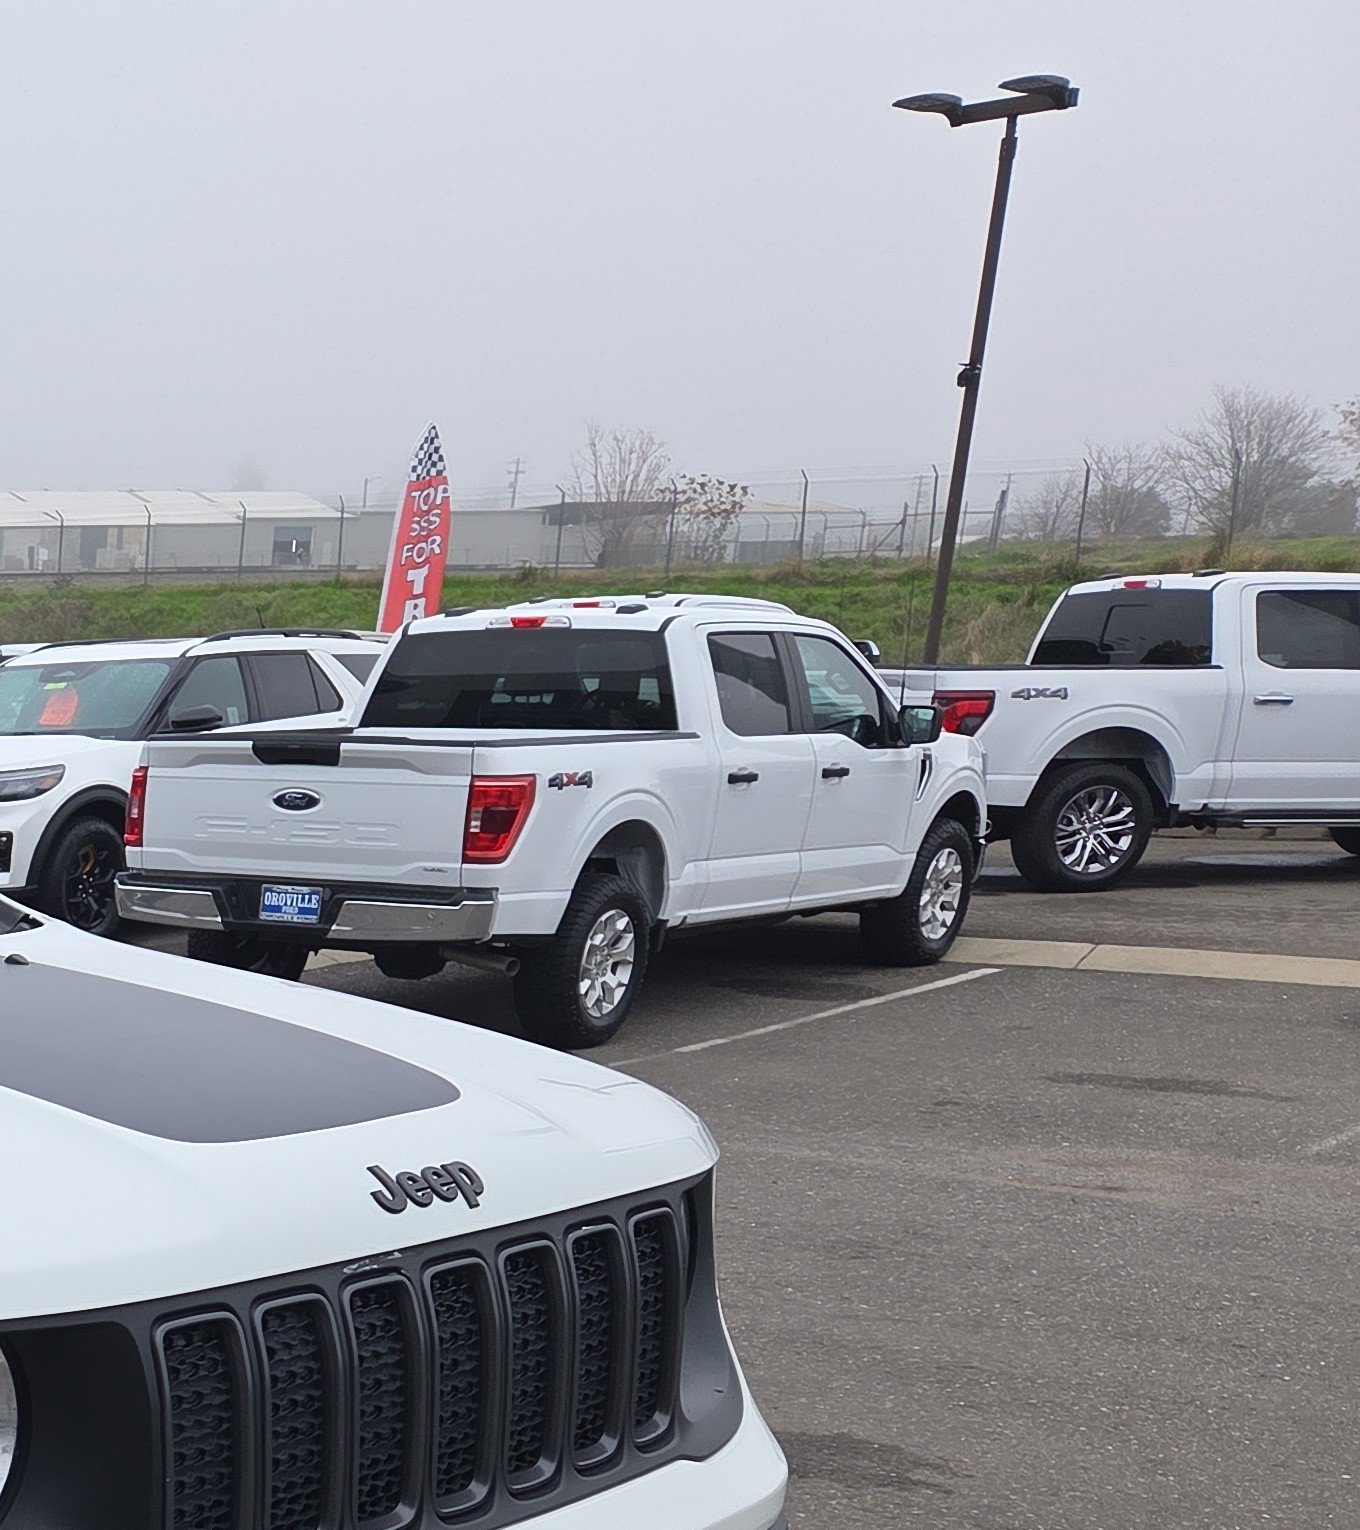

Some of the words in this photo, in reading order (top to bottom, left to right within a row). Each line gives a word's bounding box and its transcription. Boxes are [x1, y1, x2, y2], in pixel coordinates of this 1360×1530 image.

[411, 485, 450, 512] TOP
[401, 535, 442, 566] FOR
[282, 793, 308, 807] Ford
[264, 891, 319, 908] OROVILLE
[366, 1160, 484, 1214] Jeep
